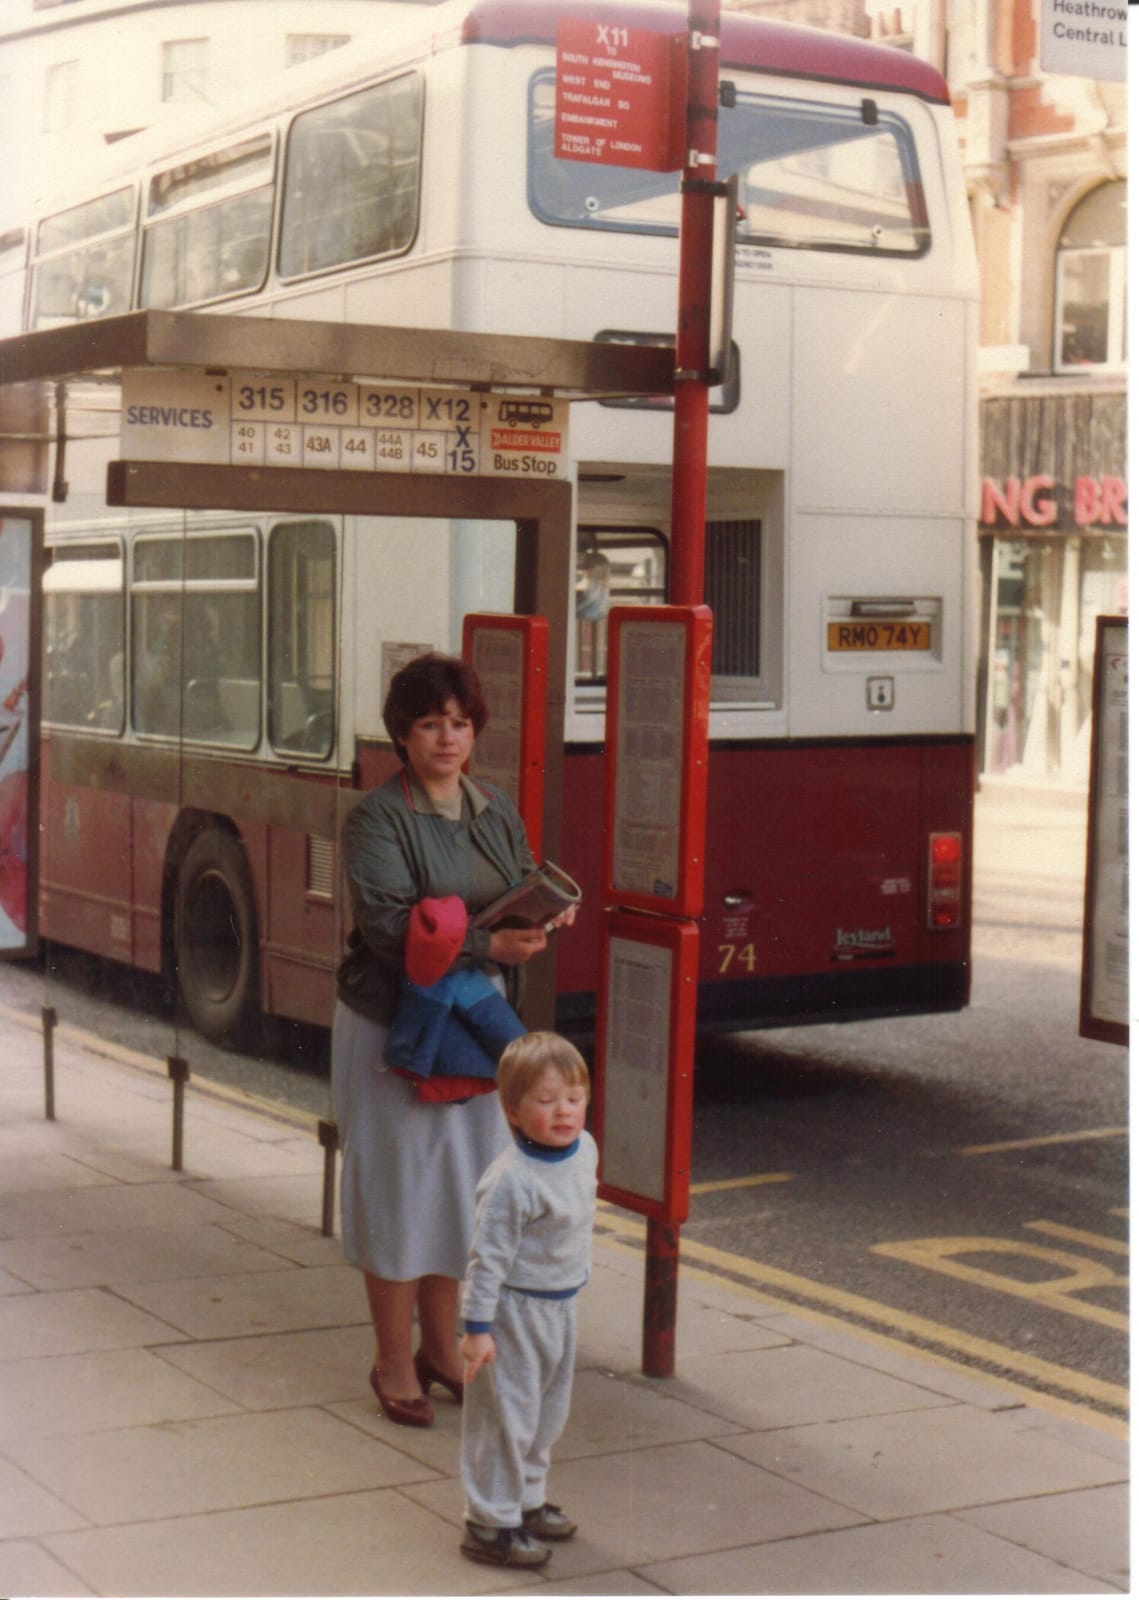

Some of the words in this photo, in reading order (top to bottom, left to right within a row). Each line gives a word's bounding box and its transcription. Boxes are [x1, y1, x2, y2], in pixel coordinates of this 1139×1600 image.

[1053, 0, 1128, 20] Heathrow
[596, 24, 628, 47] X11
[1053, 22, 1114, 45] Central
[562, 52, 589, 65] SOUTH
[593, 57, 641, 72] KENSINGTON
[562, 75, 587, 87] WEST
[593, 79, 611, 90] END
[612, 71, 652, 85] MUSEUMS
[562, 92, 611, 107] TRAFALGAR
[561, 112, 618, 128] EMBANKMENT
[561, 133, 590, 145] TOWER
[595, 138, 606, 147] OF
[610, 141, 642, 152] LONDON
[561, 143, 602, 156] ALDGATE
[239, 386, 285, 411] 315
[303, 389, 348, 415] 316
[366, 393, 414, 419] 328
[127, 405, 213, 429] SERVICES
[425, 396, 470, 422] X12
[238, 426, 255, 439] 40
[274, 428, 290, 440] 42
[378, 433, 403, 447] 44A
[455, 425, 471, 449] X
[502, 432, 529, 447] ALDER
[530, 434, 560, 449] VALLEY
[238, 442, 254, 454] 41
[276, 443, 292, 455] 43
[306, 436, 332, 453] 43A
[345, 438, 367, 455] 44
[378, 447, 403, 460] 44B
[416, 442, 438, 459] 45
[447, 449, 476, 473] 15
[494, 453, 518, 471] Bus
[522, 456, 557, 475] Stop
[982, 475, 1057, 525] NG
[1074, 475, 1128, 525] BR
[838, 626, 878, 648] RMO
[882, 625, 921, 648] 74Y
[718, 943, 757, 973] 74
